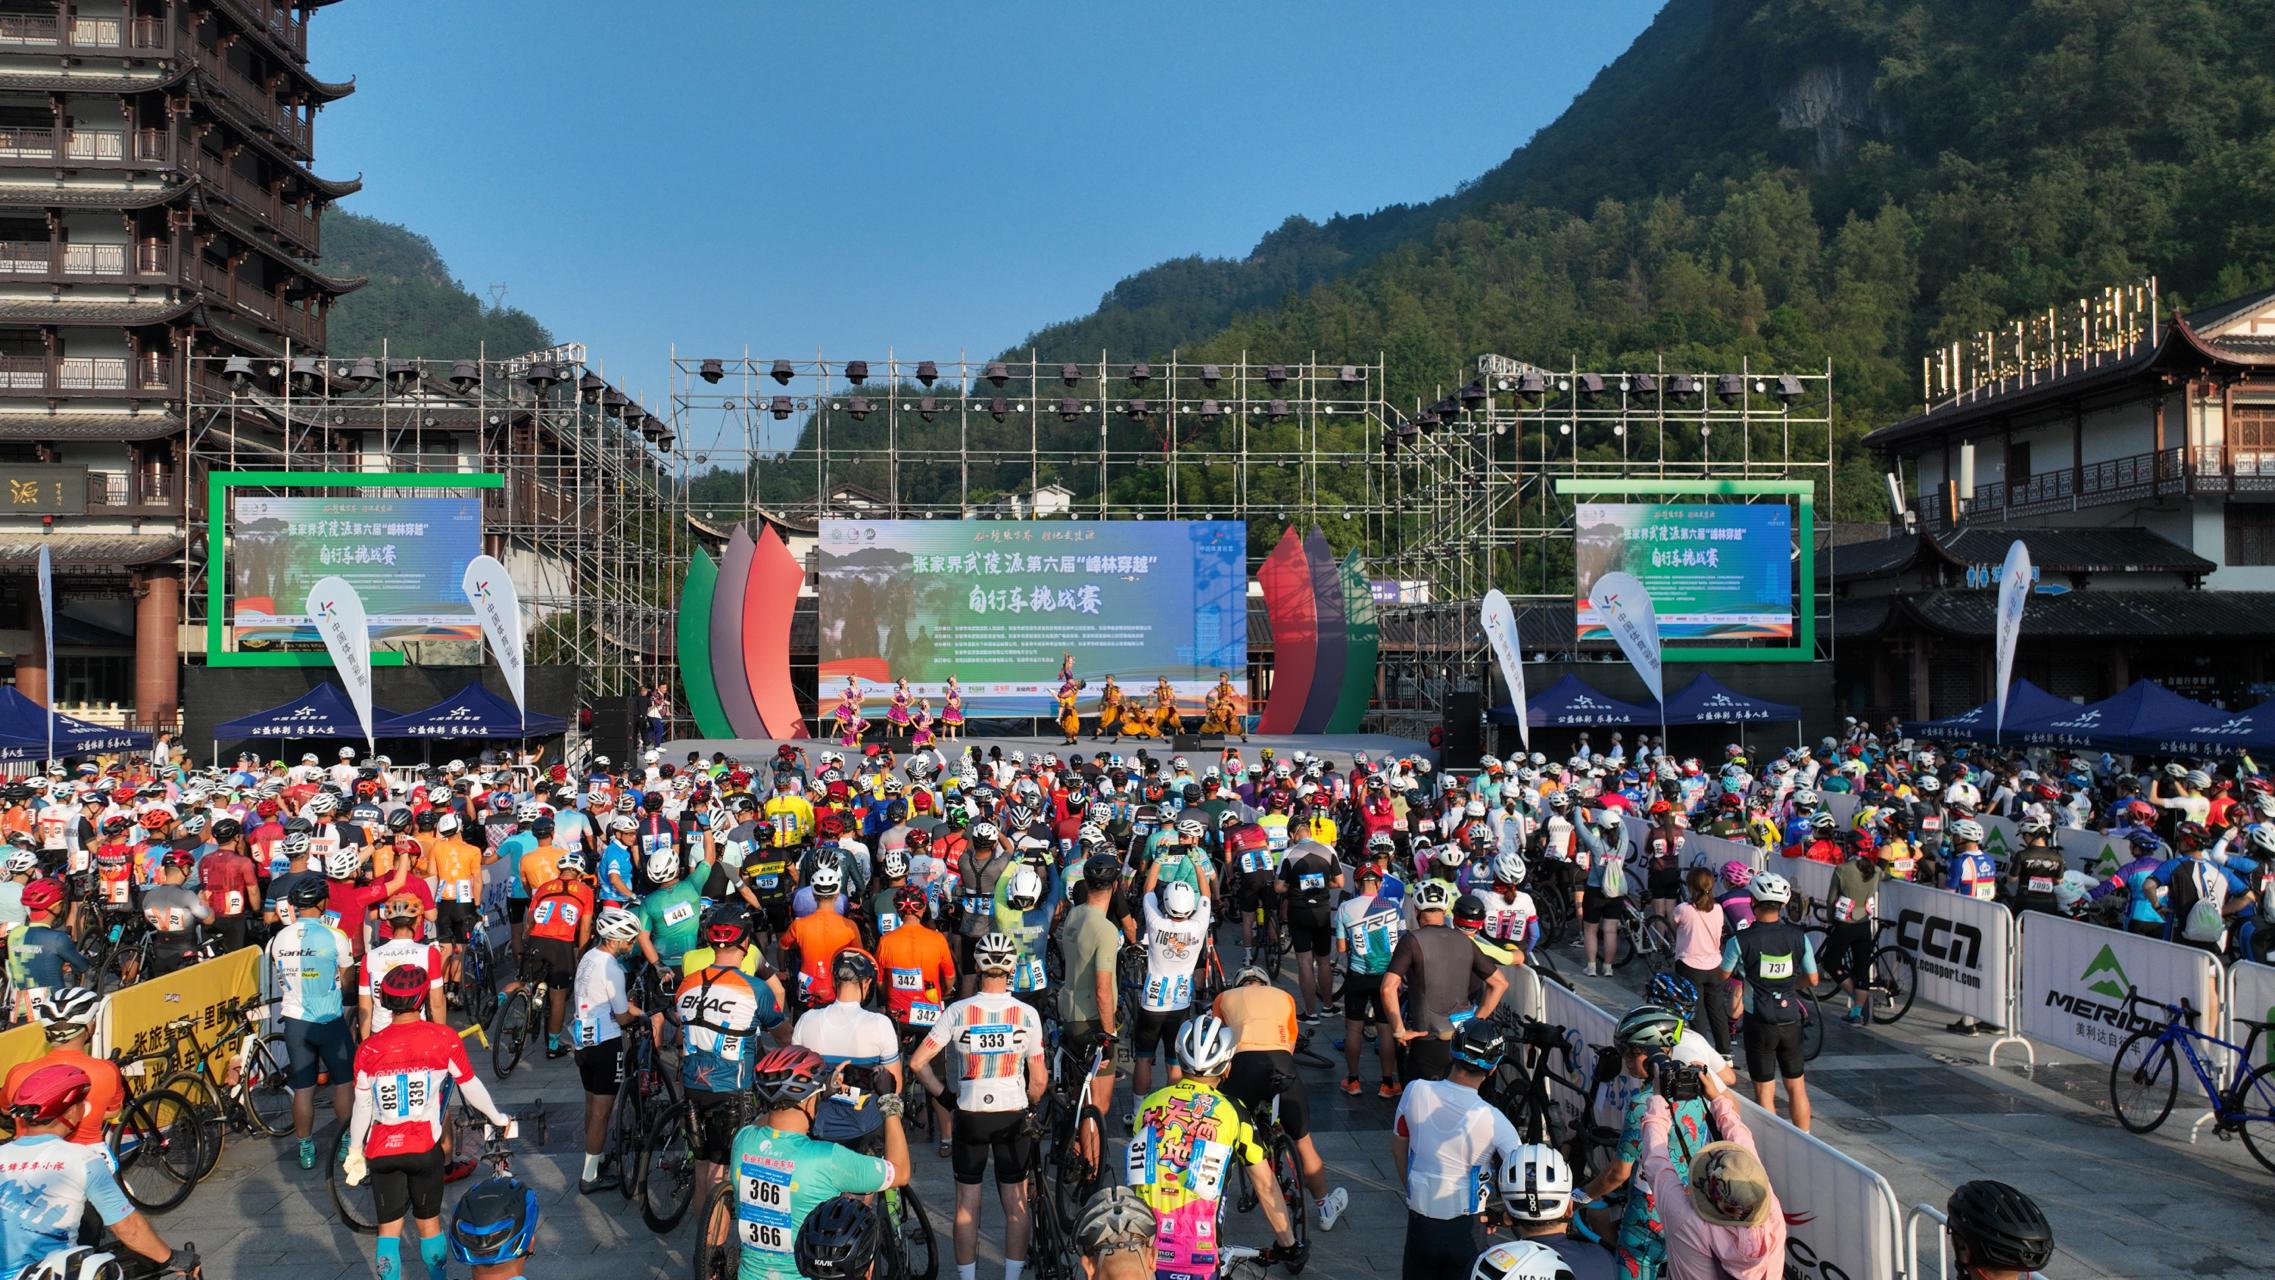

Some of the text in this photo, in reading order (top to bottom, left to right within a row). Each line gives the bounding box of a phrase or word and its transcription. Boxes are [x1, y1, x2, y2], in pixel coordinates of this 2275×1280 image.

[968, 584, 1103, 615] 自行车挑战赛
[2203, 743, 2238, 757] 乐善人
[280, 906, 289, 918] 21
[672, 908, 687, 920] 441
[1512, 919, 1525, 935] 615
[1353, 933, 1365, 949] 372
[278, 948, 317, 958] Santic
[1769, 962, 1786, 974] 737
[897, 975, 916, 986] 342
[1148, 980, 1161, 1000] 384
[917, 1009, 936, 1022] 342
[979, 1033, 1005, 1047] 333
[381, 1085, 397, 1111] 338
[409, 1080, 424, 1107] 338
[1130, 1140, 1147, 1171] 311
[1198, 1156, 1221, 1185] 311
[750, 1179, 780, 1205] 366
[749, 1222, 781, 1247] 366
